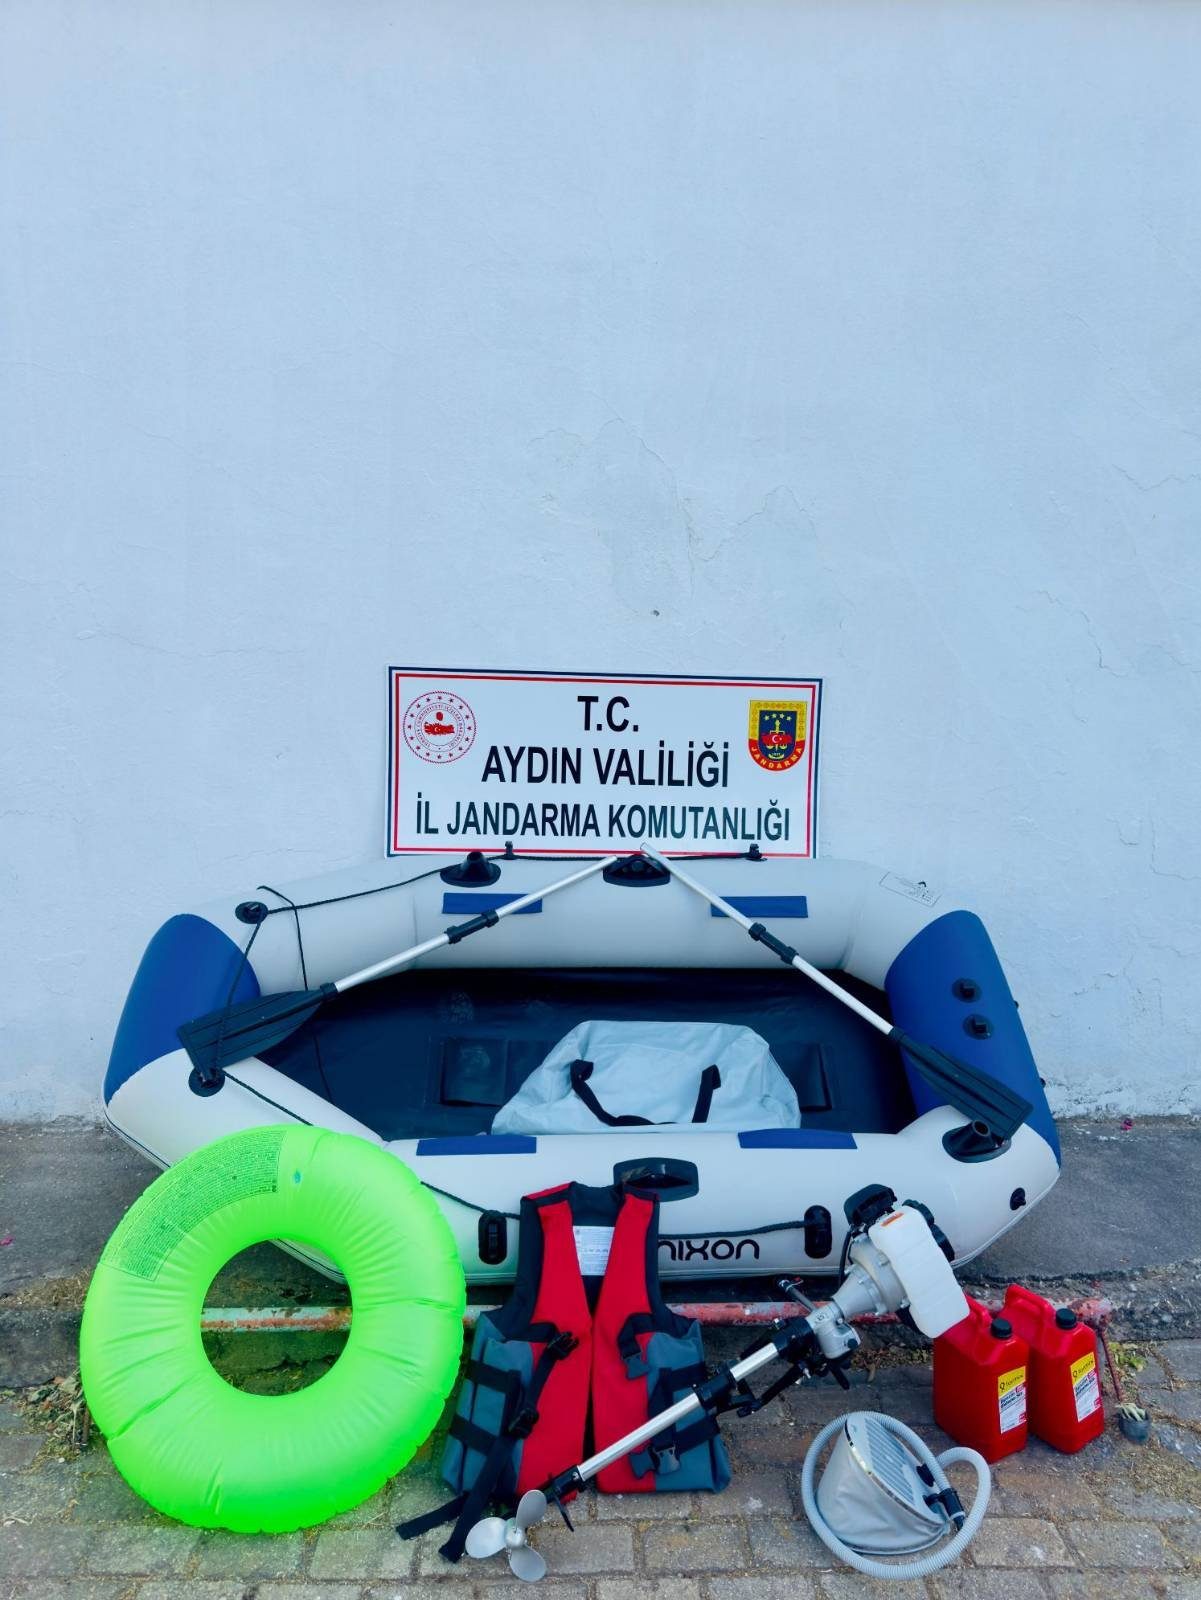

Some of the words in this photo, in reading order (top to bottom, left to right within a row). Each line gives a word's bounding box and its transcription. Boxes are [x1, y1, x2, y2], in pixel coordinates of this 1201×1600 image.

[577, 695, 639, 733] T.C.
[481, 745, 582, 785] AYDIN
[593, 740, 729, 788] VALİLİĞİ
[751, 746, 802, 769] JANDARMA
[416, 792, 439, 835] İL
[447, 801, 601, 838] JANDARMA
[609, 799, 790, 841] KOMUTANLIĞI
